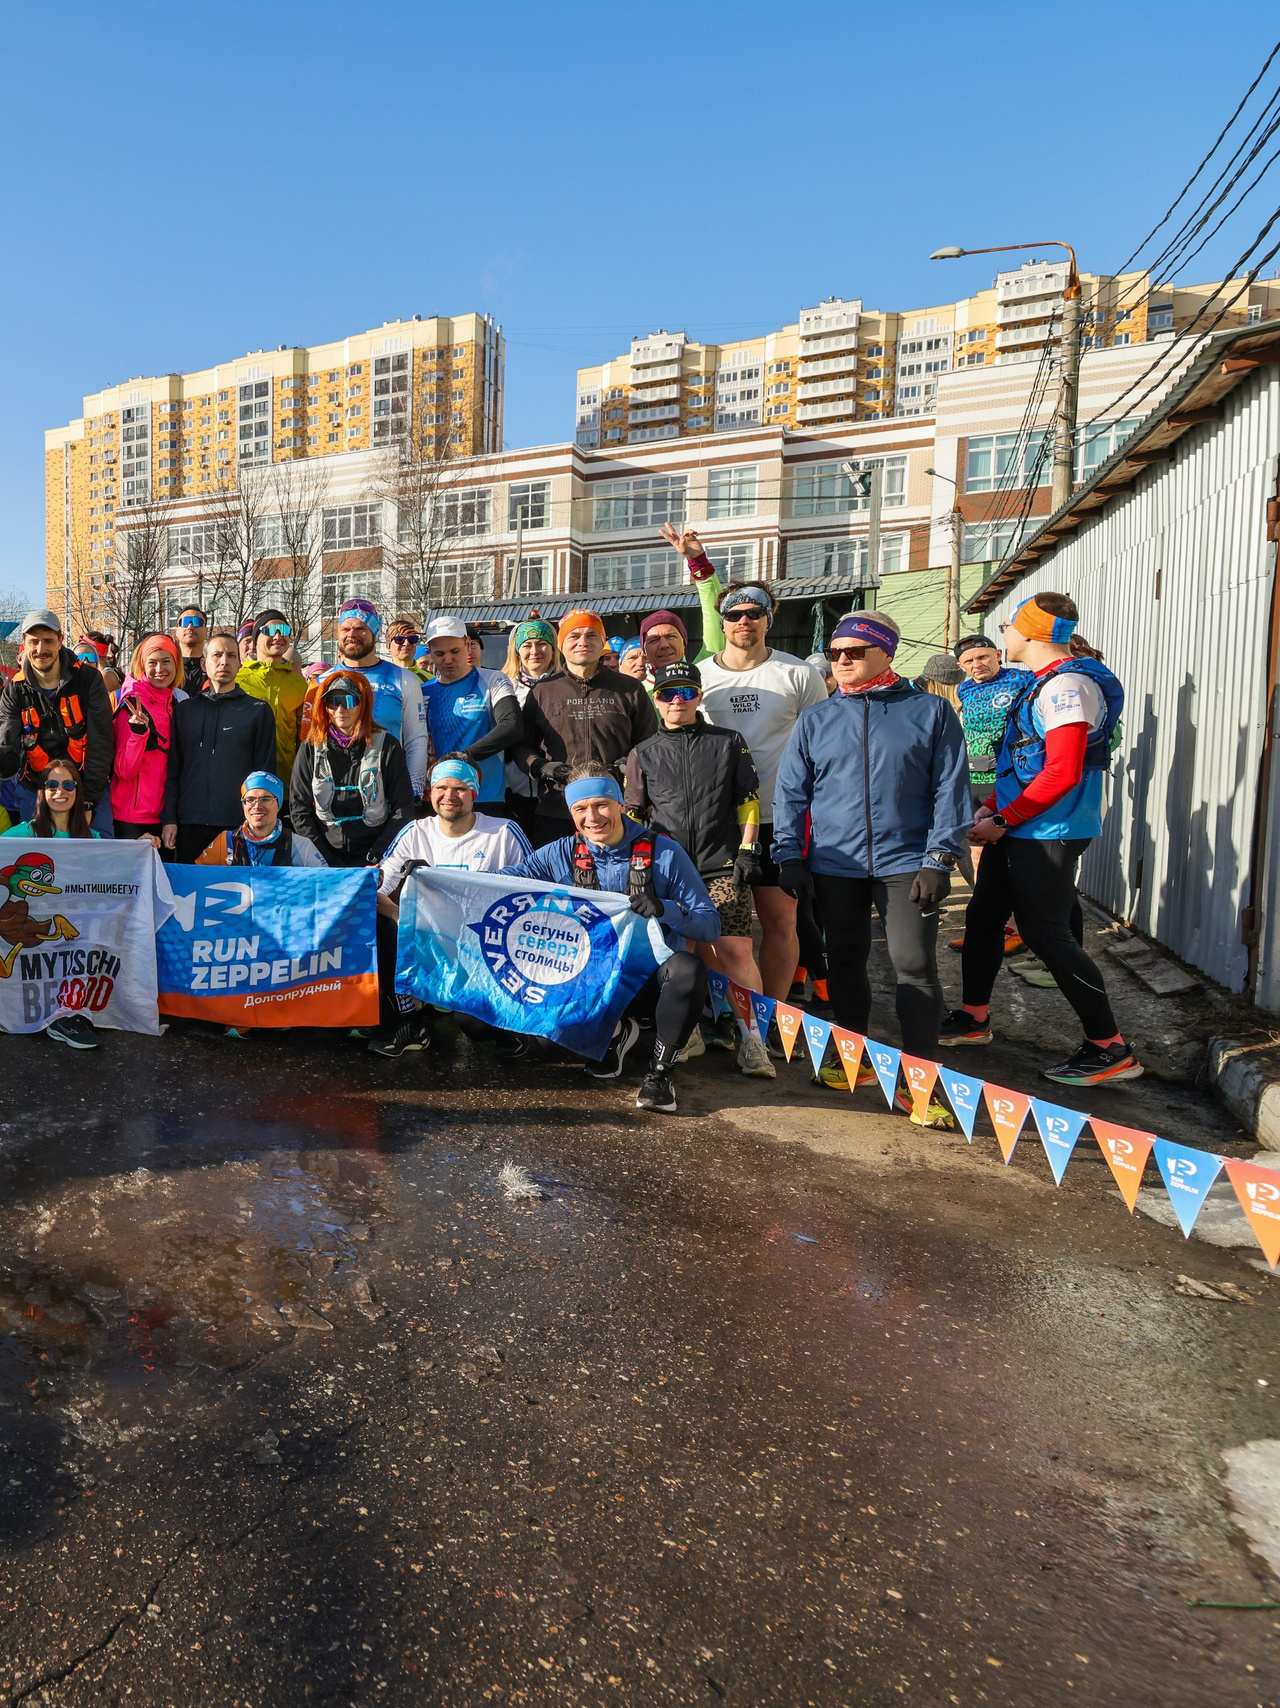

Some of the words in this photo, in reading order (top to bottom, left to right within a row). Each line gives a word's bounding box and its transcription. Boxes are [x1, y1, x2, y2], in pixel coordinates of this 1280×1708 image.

[666, 669, 689, 677] VLNT
[731, 694, 758, 703] TEAM
[64, 884, 140, 896] #МЫТИЩИБЕГУТ
[522, 920, 580, 944] бегуны
[192, 935, 260, 963] RUN
[517, 933, 579, 960] севера
[514, 948, 575, 974] столицы
[190, 946, 343, 990] ZEPPELIN
[243, 979, 342, 1009] Долгопрудный
[1112, 1154, 1124, 1162] RUN
[1112, 1160, 1137, 1172] ZEPPELIN
[1170, 1175, 1184, 1185] RUN
[1170, 1180, 1199, 1195] ZEPPELIN
[1251, 1200, 1267, 1211] RUN
